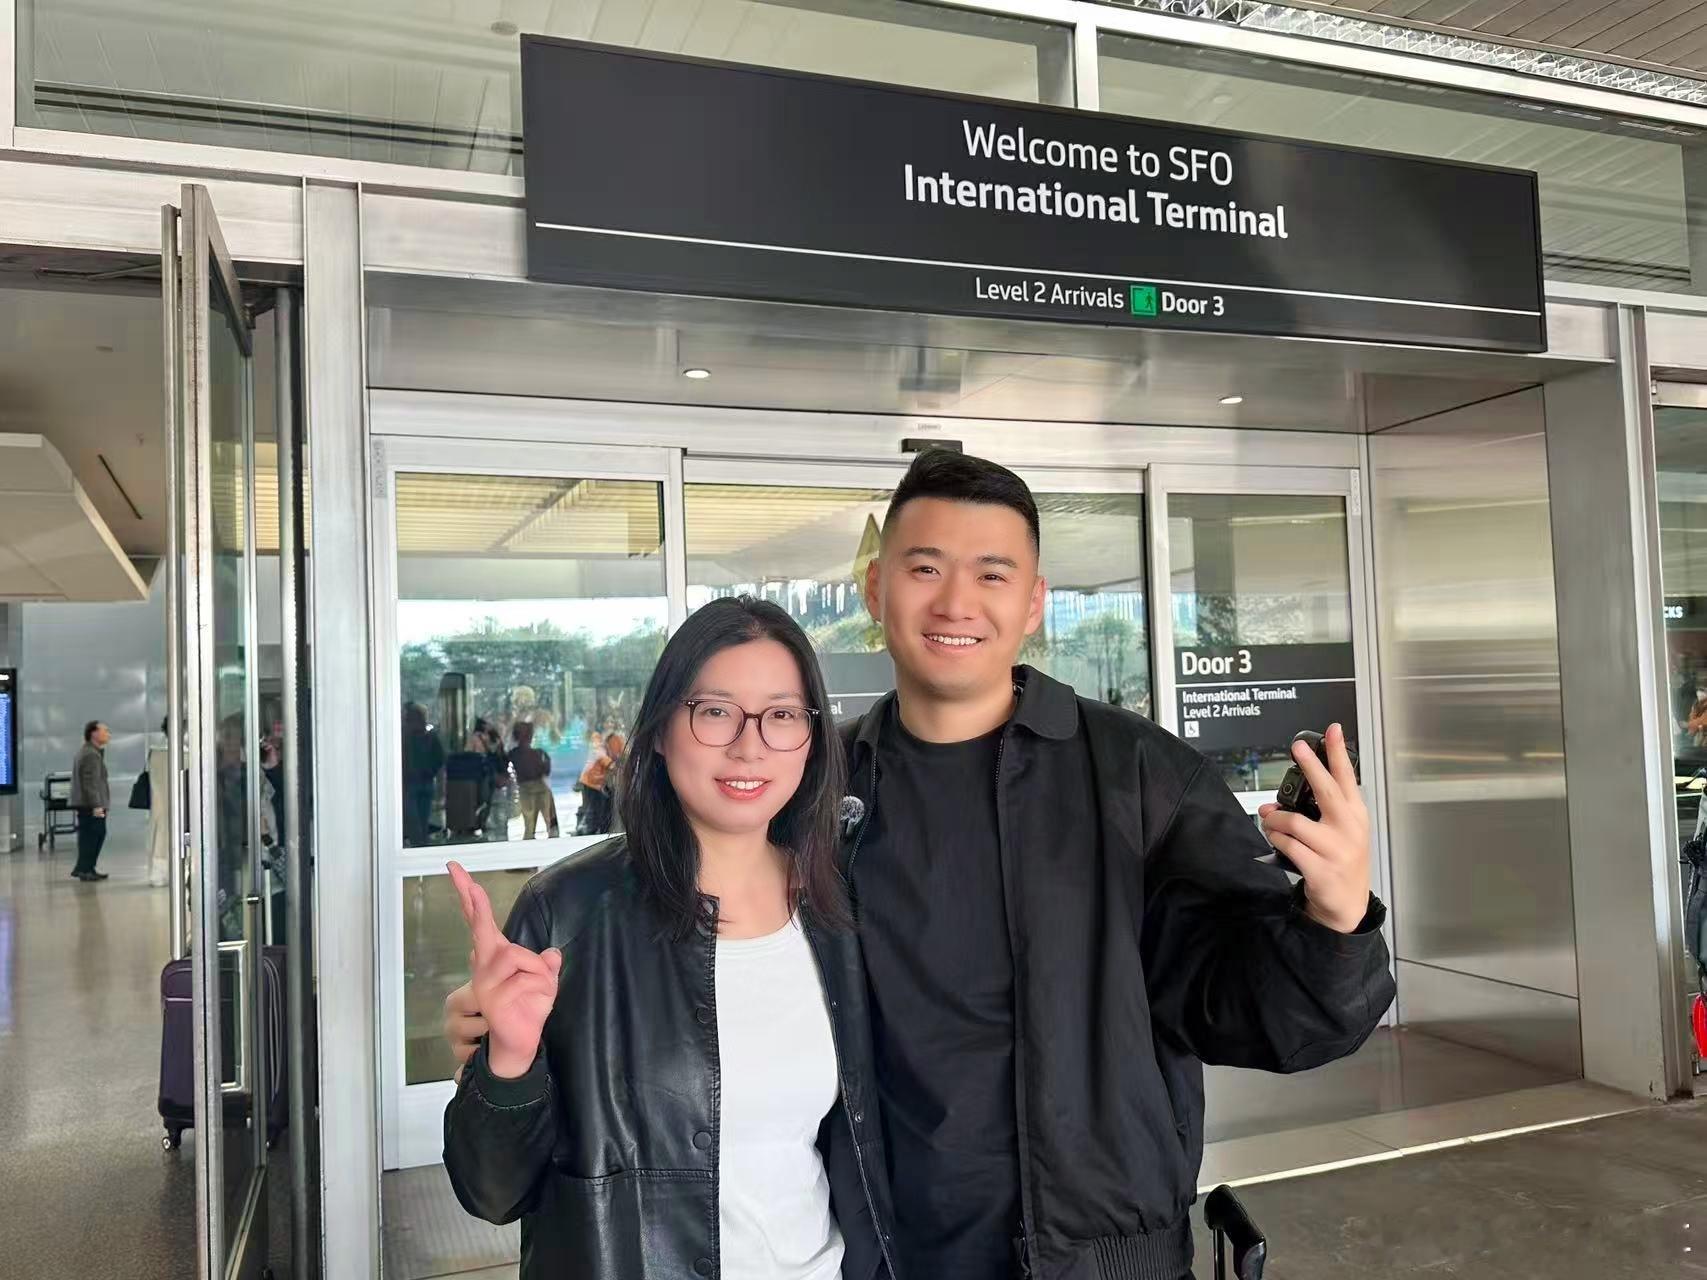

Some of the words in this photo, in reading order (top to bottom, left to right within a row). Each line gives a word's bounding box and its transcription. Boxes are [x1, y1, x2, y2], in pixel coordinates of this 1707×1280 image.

[962, 119, 1118, 174] Welcome
[1126, 144, 1160, 178] to
[1169, 146, 1233, 187] SFO
[904, 163, 1140, 224] International
[1147, 191, 1289, 239] Terminal
[976, 276, 1030, 302] Level
[1033, 281, 1046, 303] 2
[1050, 283, 1125, 309] Arrivals
[1161, 291, 1208, 315] Door
[1212, 295, 1225, 317] 3
[1181, 651, 1234, 676] Door
[1238, 649, 1252, 674] 3
[1182, 688, 1250, 703] International
[1251, 686, 1297, 701] Terminal
[1183, 705, 1212, 719] Level
[1212, 704, 1221, 717] 2
[1221, 703, 1261, 717] Arrivals
